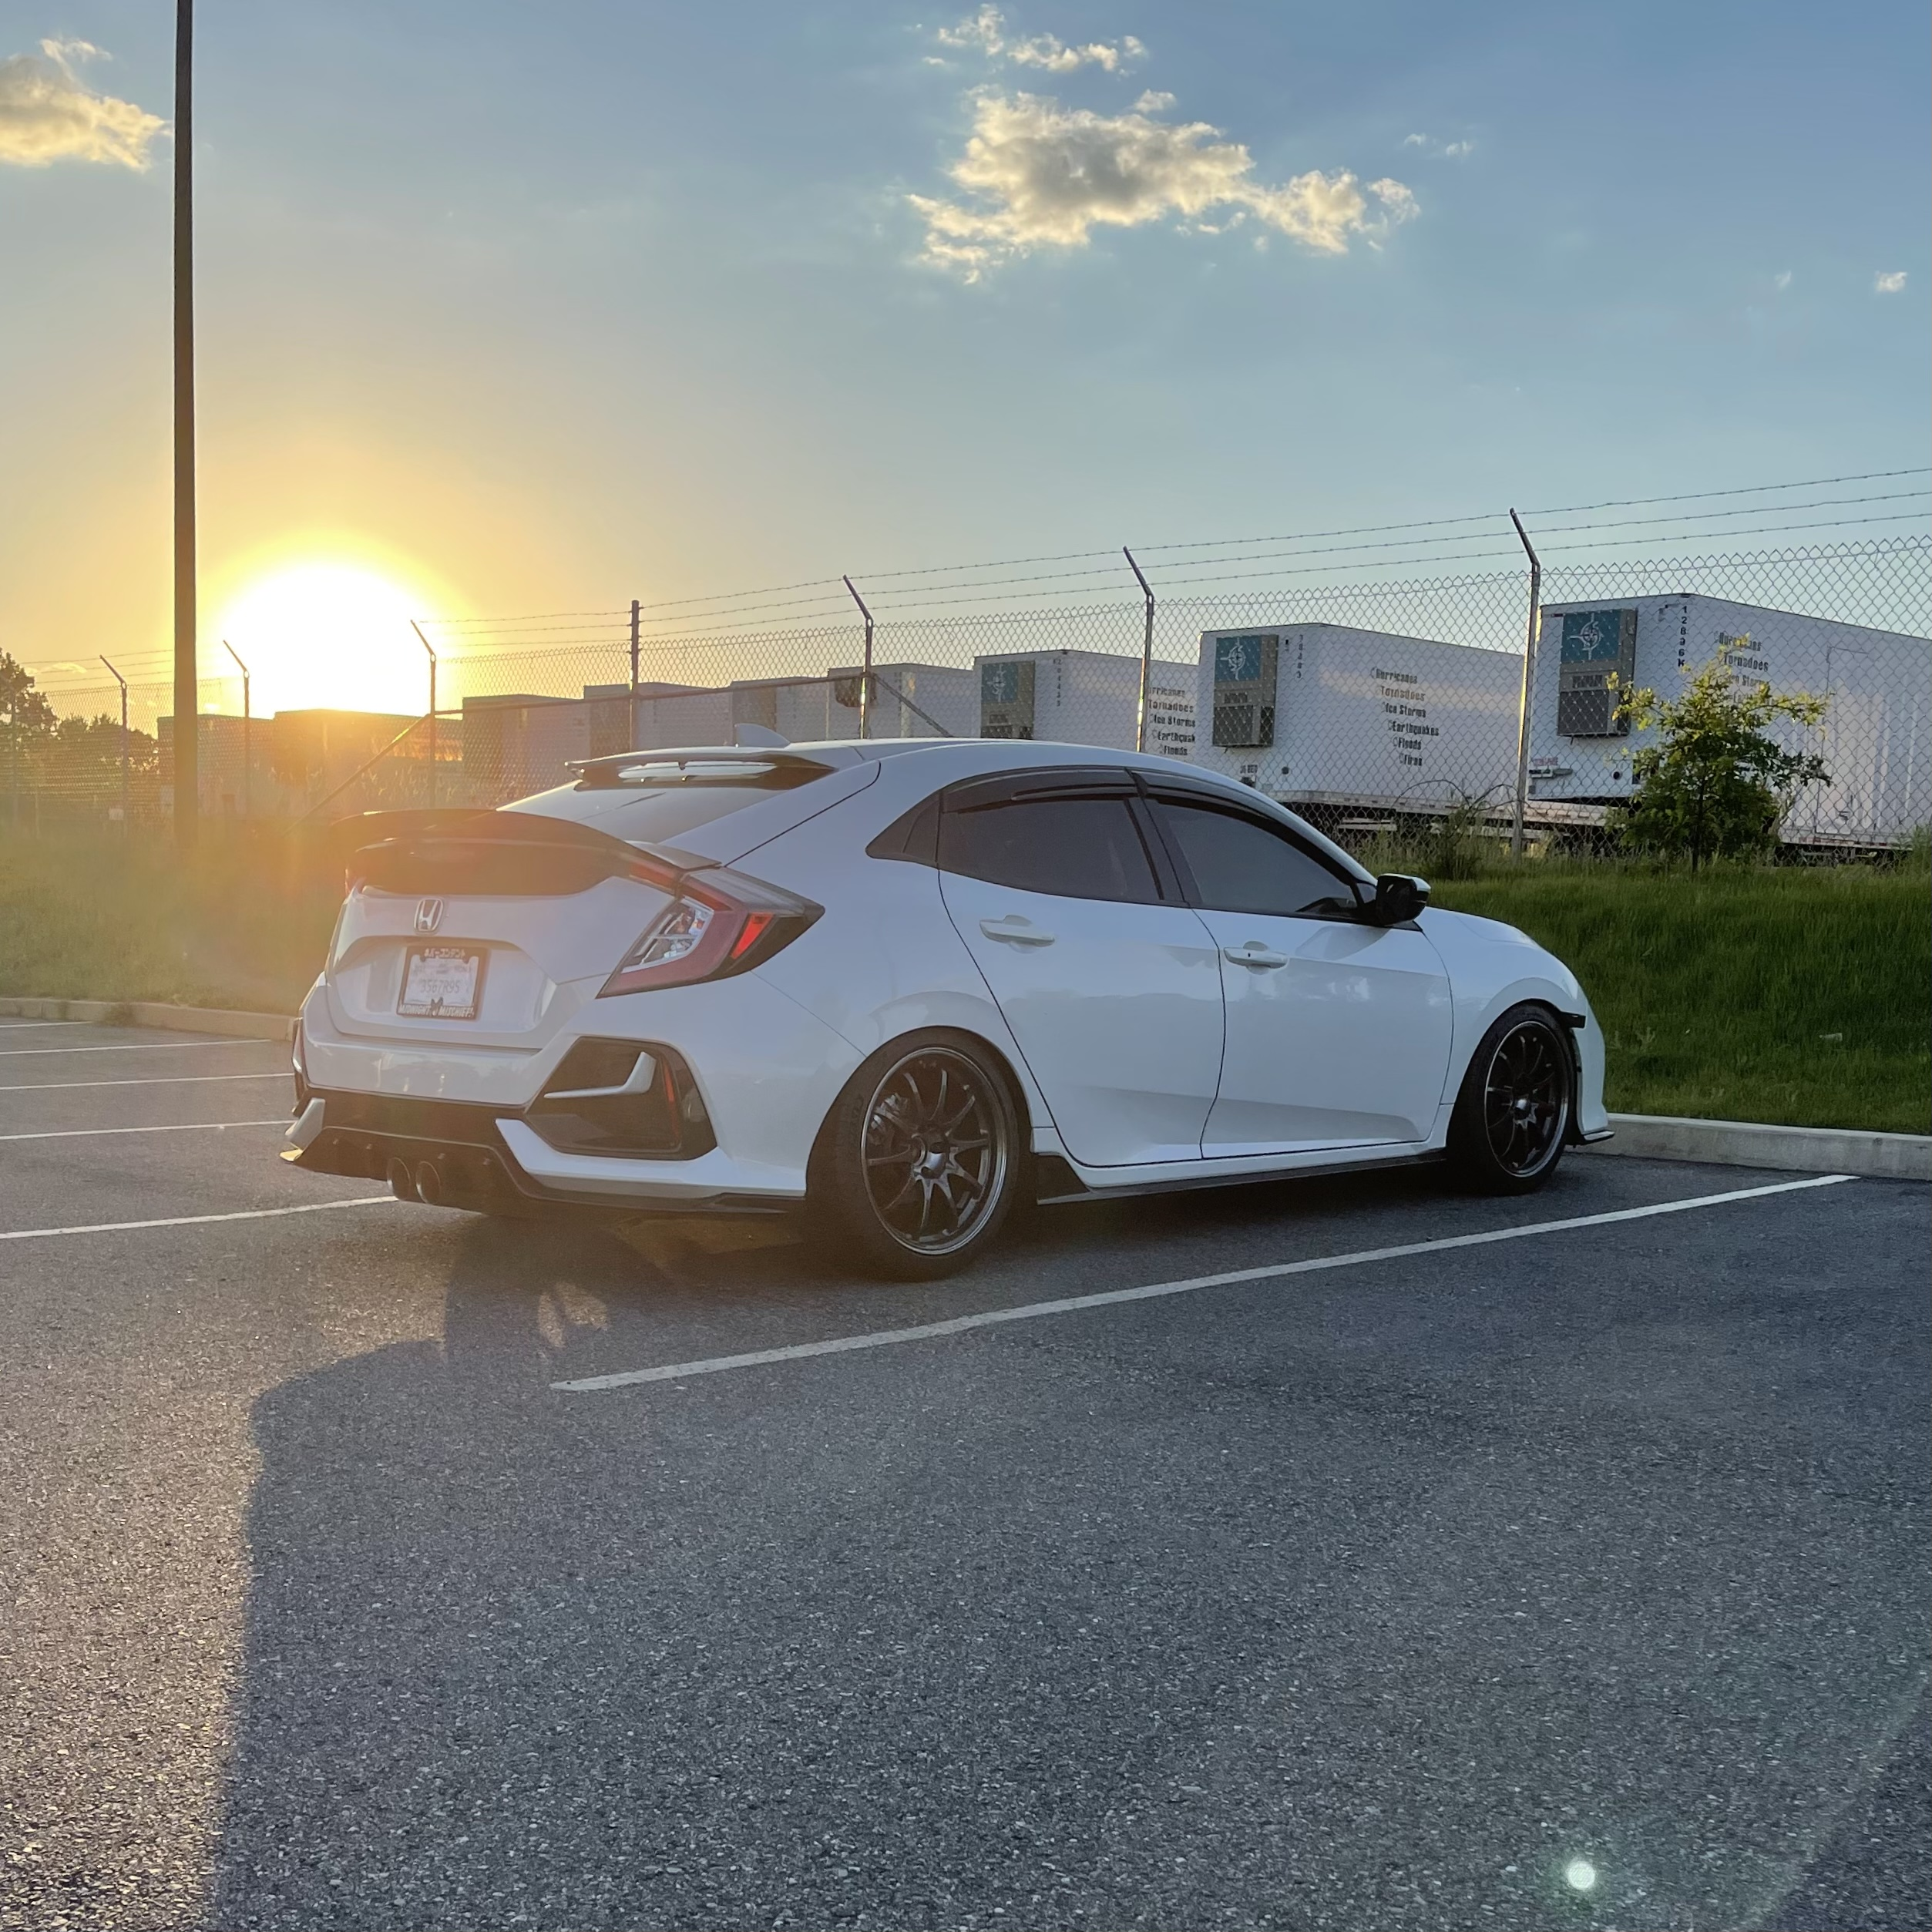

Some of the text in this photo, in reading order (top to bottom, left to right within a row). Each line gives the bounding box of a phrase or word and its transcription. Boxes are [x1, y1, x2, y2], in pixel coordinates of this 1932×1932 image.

[1723, 652, 1769, 672] Tornadoes
[1376, 668, 1418, 684] Hurricanes
[1380, 685, 1426, 701] Tornadoes
[1148, 699, 1194, 713] Tornadoes
[1399, 704, 1426, 718] Storms
[1168, 716, 1196, 727] Storms
[1392, 721, 1440, 737] Earthquakes
[1398, 737, 1422, 750] Floods
